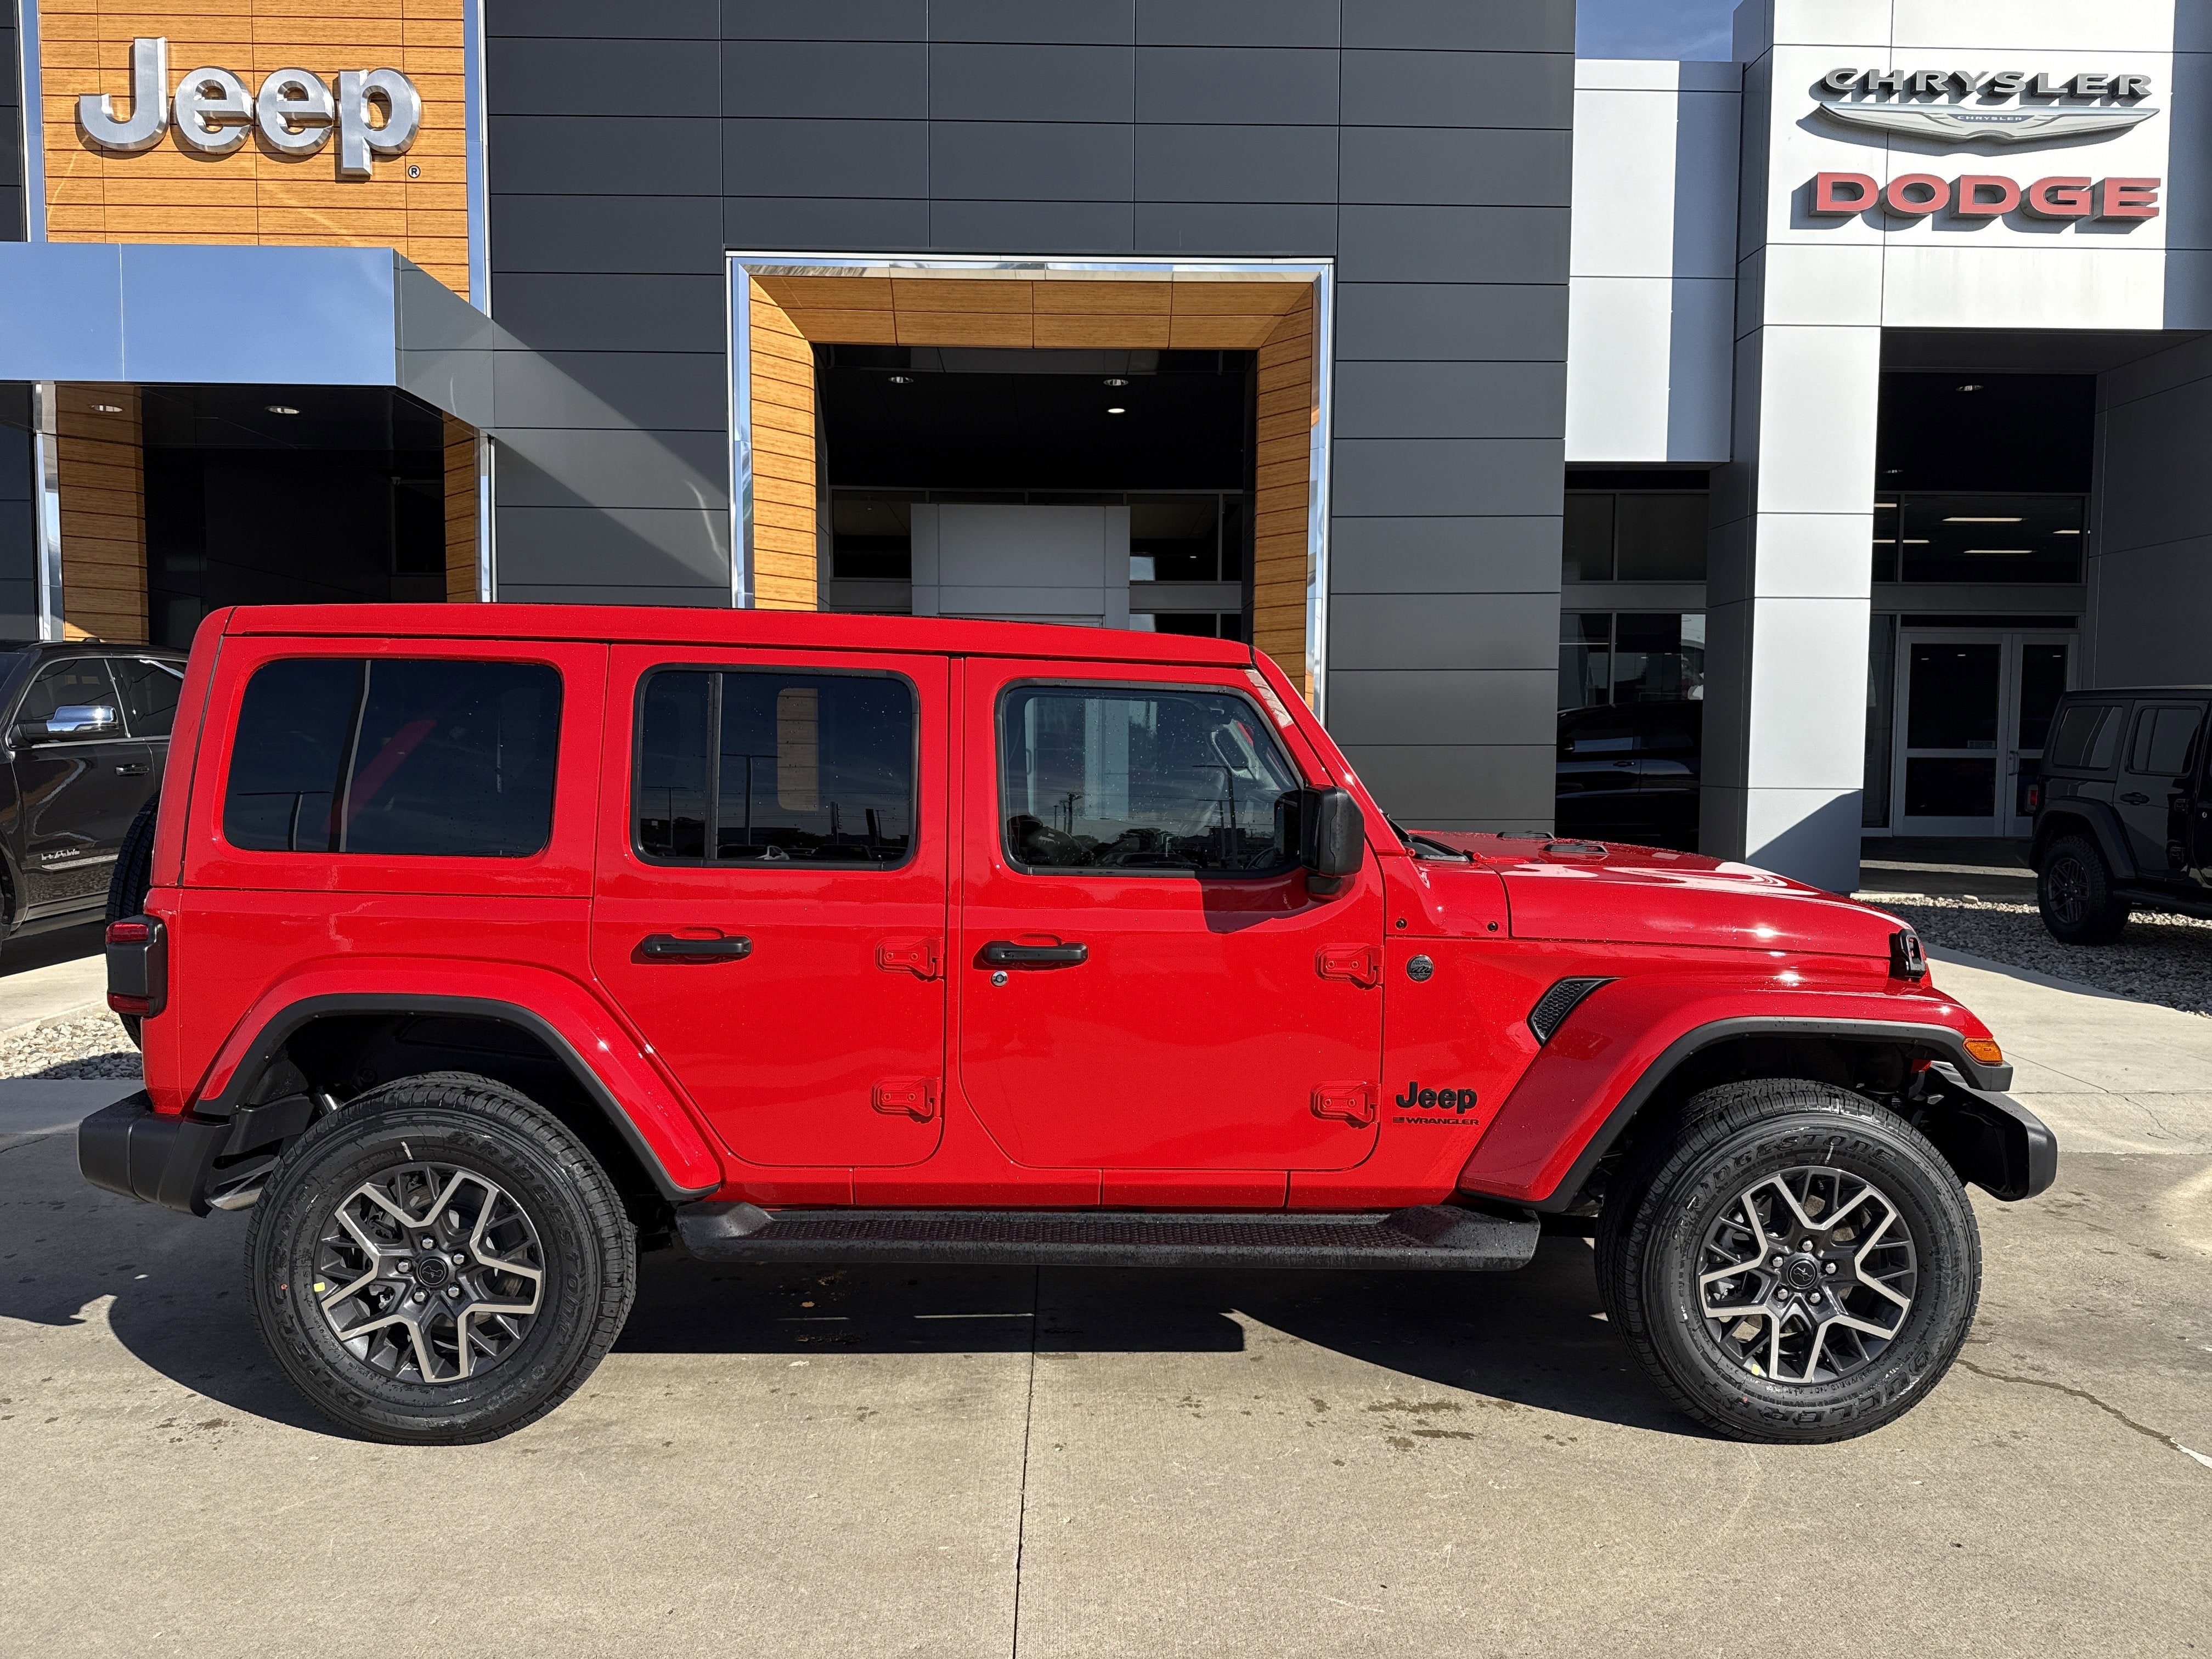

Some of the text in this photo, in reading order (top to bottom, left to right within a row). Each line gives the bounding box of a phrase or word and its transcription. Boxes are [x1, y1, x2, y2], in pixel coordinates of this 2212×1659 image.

[1822, 67, 2153, 98] CHRYSLER
[78, 36, 421, 177] Jeep
[1809, 172, 2162, 218] DODGE
[41, 848, 80, 861] RAM
[1396, 1081, 1478, 1114] Jeep
[1405, 1117, 1480, 1125] WRANGLER
[1672, 1132, 1897, 1248] BRIDGESTONE
